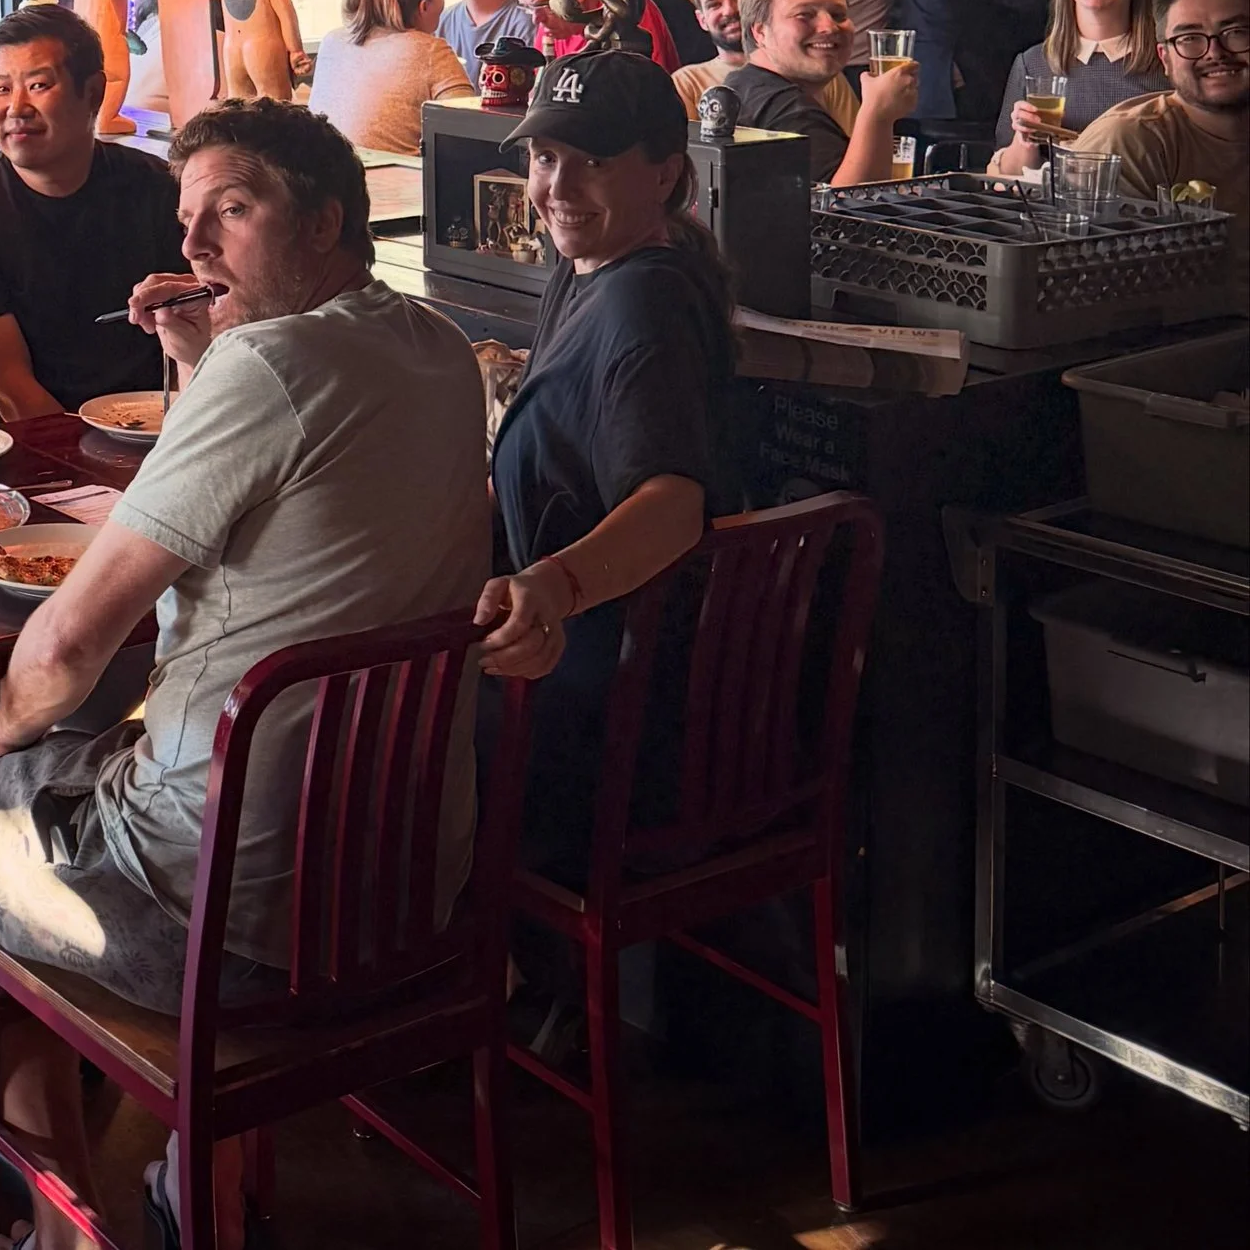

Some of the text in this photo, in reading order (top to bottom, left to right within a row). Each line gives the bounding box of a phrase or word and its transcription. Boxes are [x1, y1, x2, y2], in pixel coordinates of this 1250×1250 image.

[552, 67, 584, 103] LA
[774, 395, 839, 430] Please
[774, 421, 835, 455] Wear a
[803, 454, 850, 483] Mask
